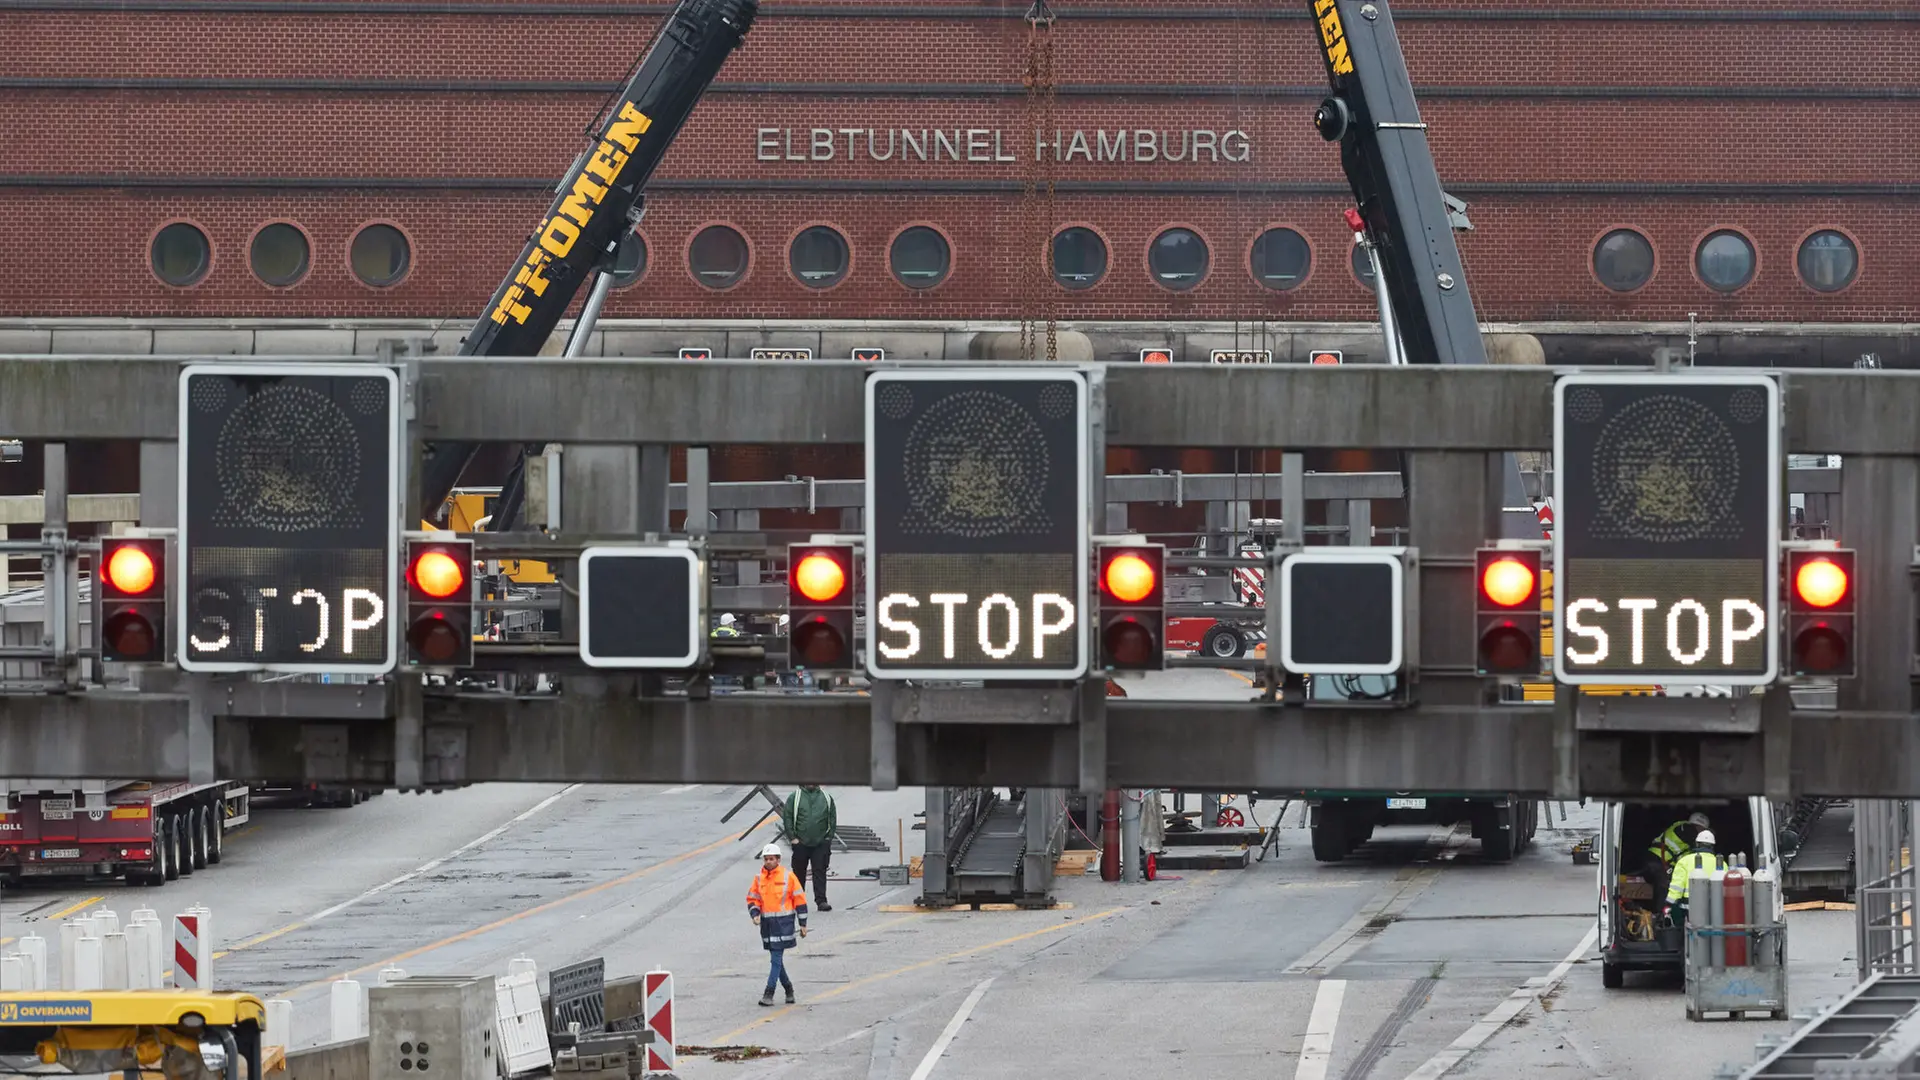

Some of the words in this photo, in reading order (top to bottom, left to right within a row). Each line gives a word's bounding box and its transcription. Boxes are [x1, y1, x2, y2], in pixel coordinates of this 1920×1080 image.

[757, 127, 1016, 162] ELBTUNNEL
[1035, 128, 1250, 162] HAMBURG
[878, 593, 1075, 659] STOP
[1566, 598, 1765, 665] STOP
[20, 1006, 89, 1017] OEVERMANN
